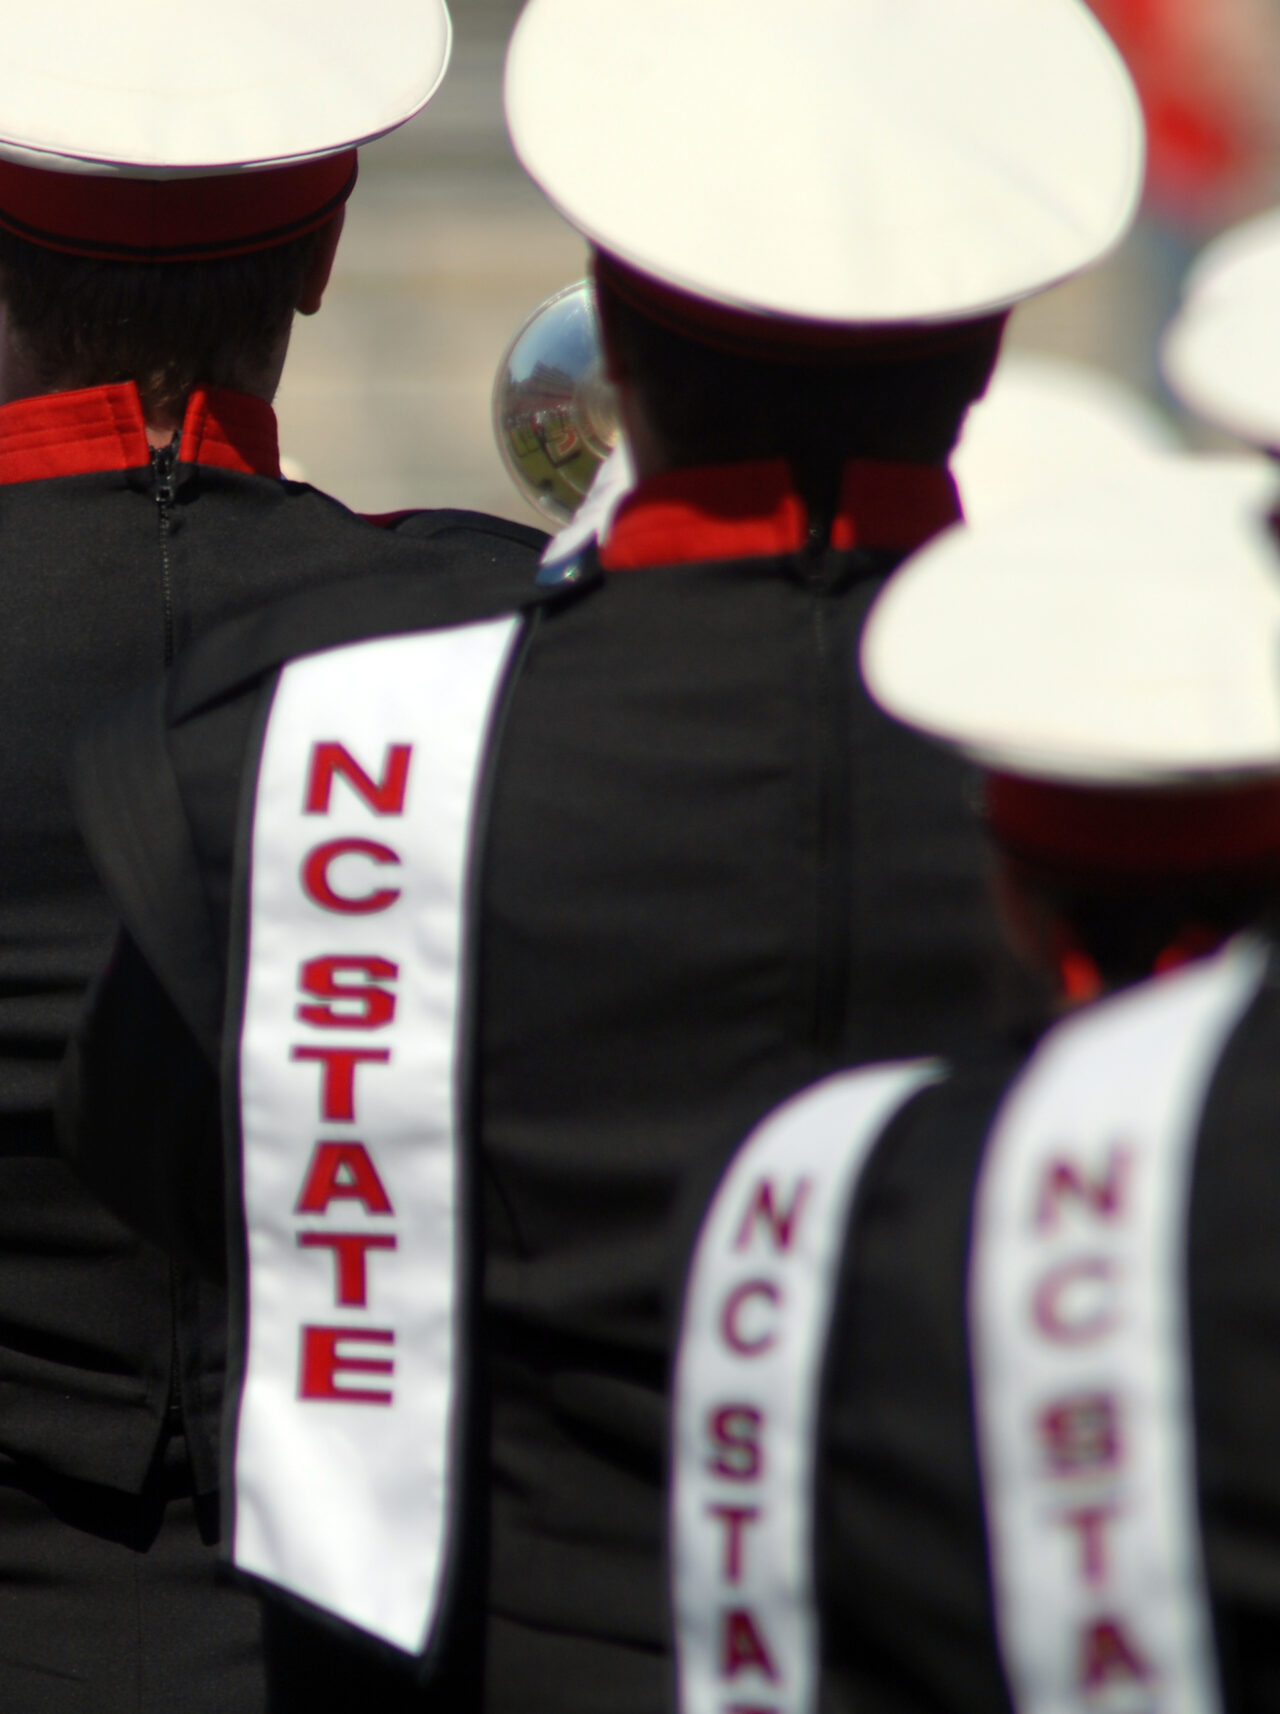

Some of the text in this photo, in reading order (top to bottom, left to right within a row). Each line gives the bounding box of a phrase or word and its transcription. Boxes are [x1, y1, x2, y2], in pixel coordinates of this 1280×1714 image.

[289, 740, 414, 1406] NC STATE
[1032, 1140, 1136, 1348] NC
[706, 1176, 811, 1714] NC STA
